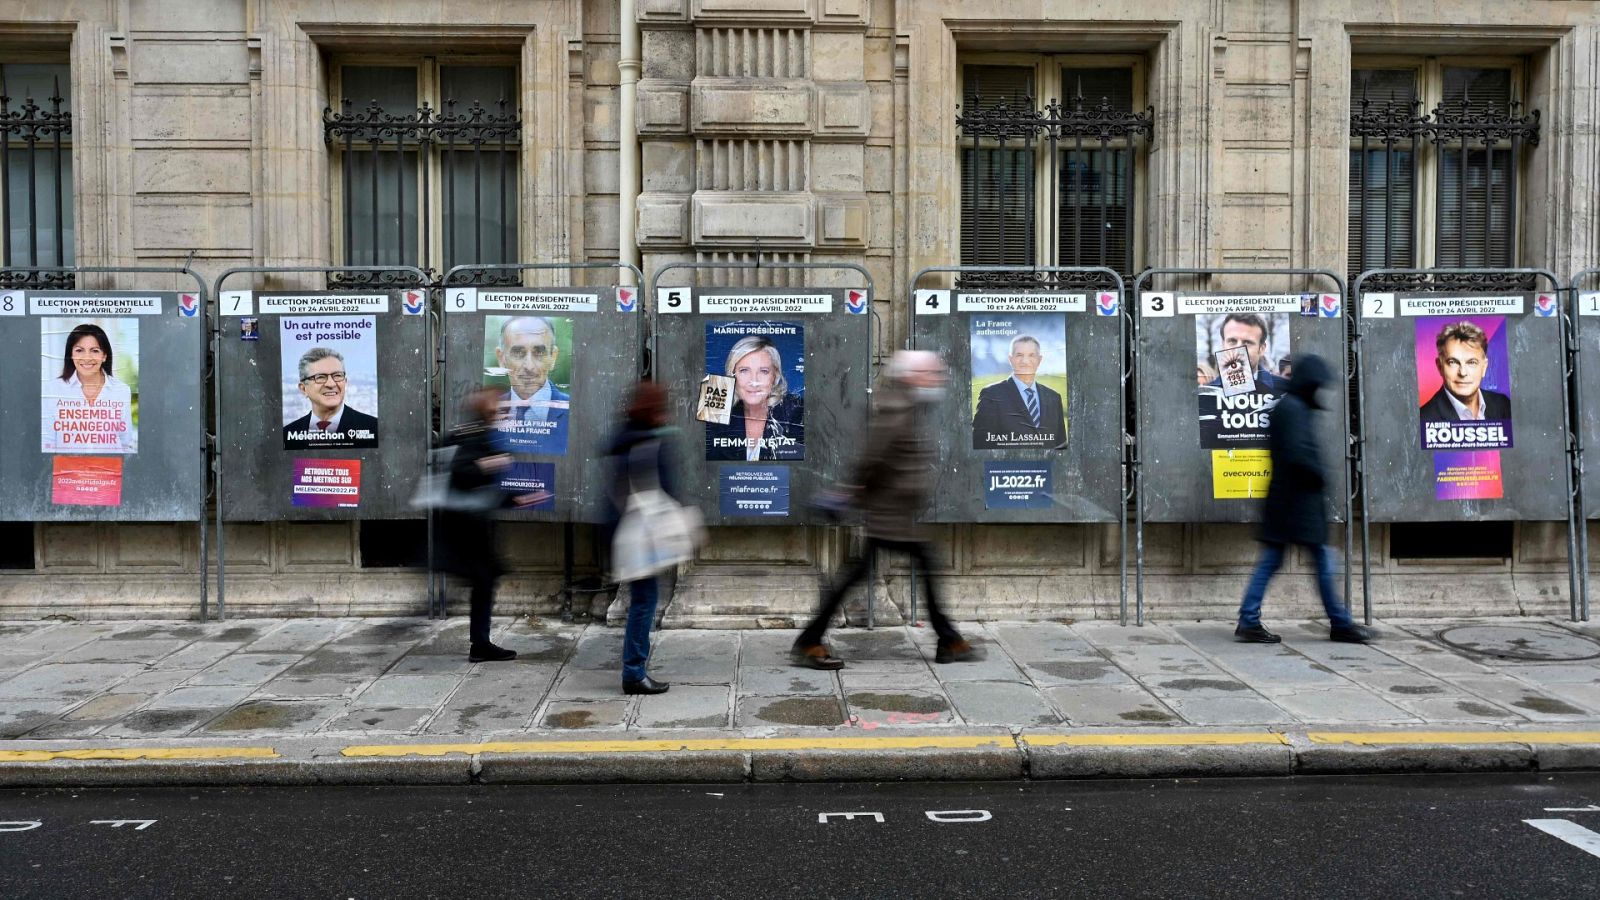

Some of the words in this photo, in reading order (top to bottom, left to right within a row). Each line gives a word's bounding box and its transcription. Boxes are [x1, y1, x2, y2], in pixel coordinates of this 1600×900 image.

[3, 296, 14, 311] 8
[38, 298, 80, 306] ÉLECTION
[83, 298, 154, 306] PRÉSIDENTIELLE
[231, 296, 241, 311] 7
[267, 297, 308, 305] ÉLECTION
[311, 296, 380, 305] PRÉSIDENTIELLE
[456, 292, 465, 307] 6
[525, 295, 590, 304] PRÉSIDENTIELLE
[667, 292, 682, 307] 5
[707, 296, 750, 304] ÉLECTION
[752, 296, 824, 304] PRÉSIDENTIELLE
[925, 294, 939, 309] 4
[1151, 297, 1164, 311] 3
[1450, 299, 1516, 307] PRÉSIDENTIELLE
[1590, 297, 1599, 311] 1
[1374, 300, 1383, 314] 2
[284, 320, 299, 329] Un
[334, 319, 372, 328] monde
[746, 326, 796, 335] PRÉSIDENTE
[316, 332, 361, 342] possible
[707, 387, 727, 397] PAS
[84, 400, 124, 409] Hidalgo
[704, 401, 725, 409] 2022
[1216, 393, 1274, 410] Nous
[59, 409, 122, 419] ENSEMBLE
[1220, 410, 1271, 428] tous
[54, 421, 126, 432] CHANGEONS
[63, 433, 116, 444] D'AVENIR
[287, 429, 345, 440] Mélenchon
[1425, 427, 1508, 442] ROUSSEL
[714, 438, 756, 447] FEMME
[990, 475, 1046, 491] JL2022.fr
